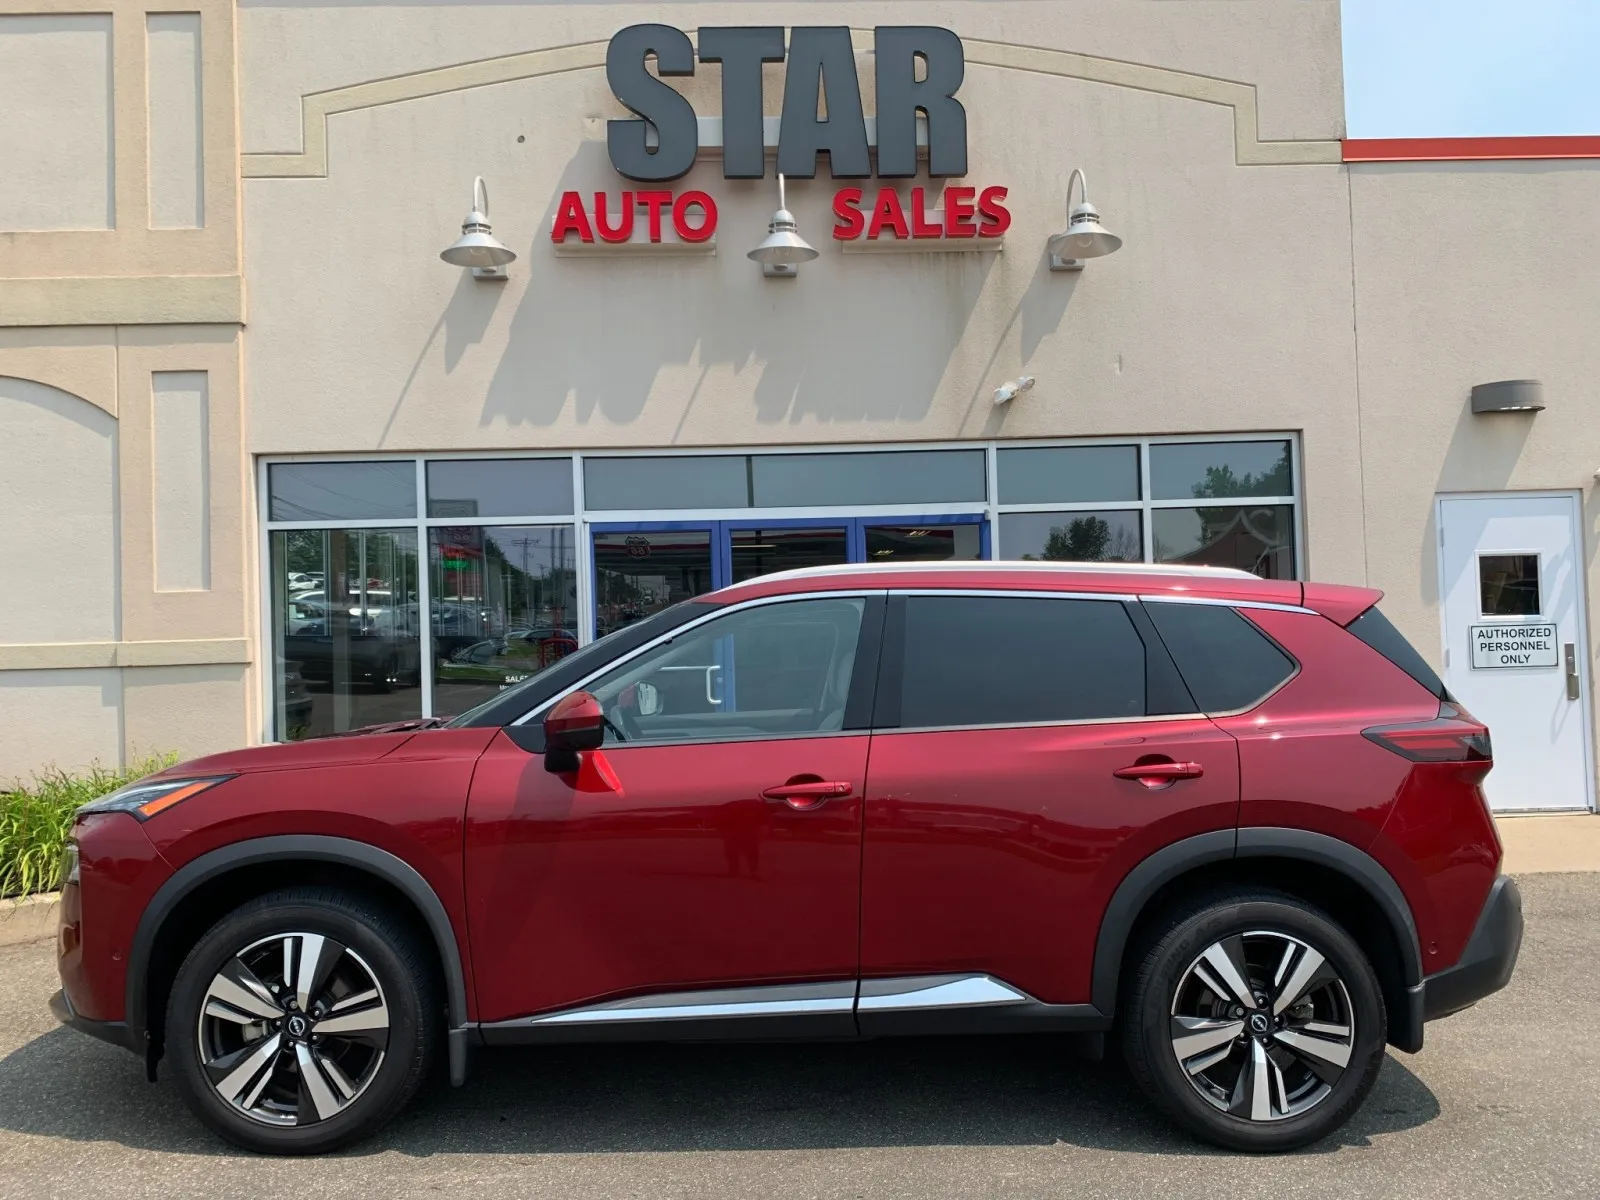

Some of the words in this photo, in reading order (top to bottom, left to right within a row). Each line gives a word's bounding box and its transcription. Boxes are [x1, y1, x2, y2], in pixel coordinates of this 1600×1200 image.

[606, 23, 968, 182] STAR
[551, 190, 719, 244] AUTO
[833, 186, 1012, 240] SALES
[1477, 627, 1552, 640] AUTHORIZED
[1480, 640, 1551, 652] PERSONNEL
[1500, 654, 1531, 664] ONLY
